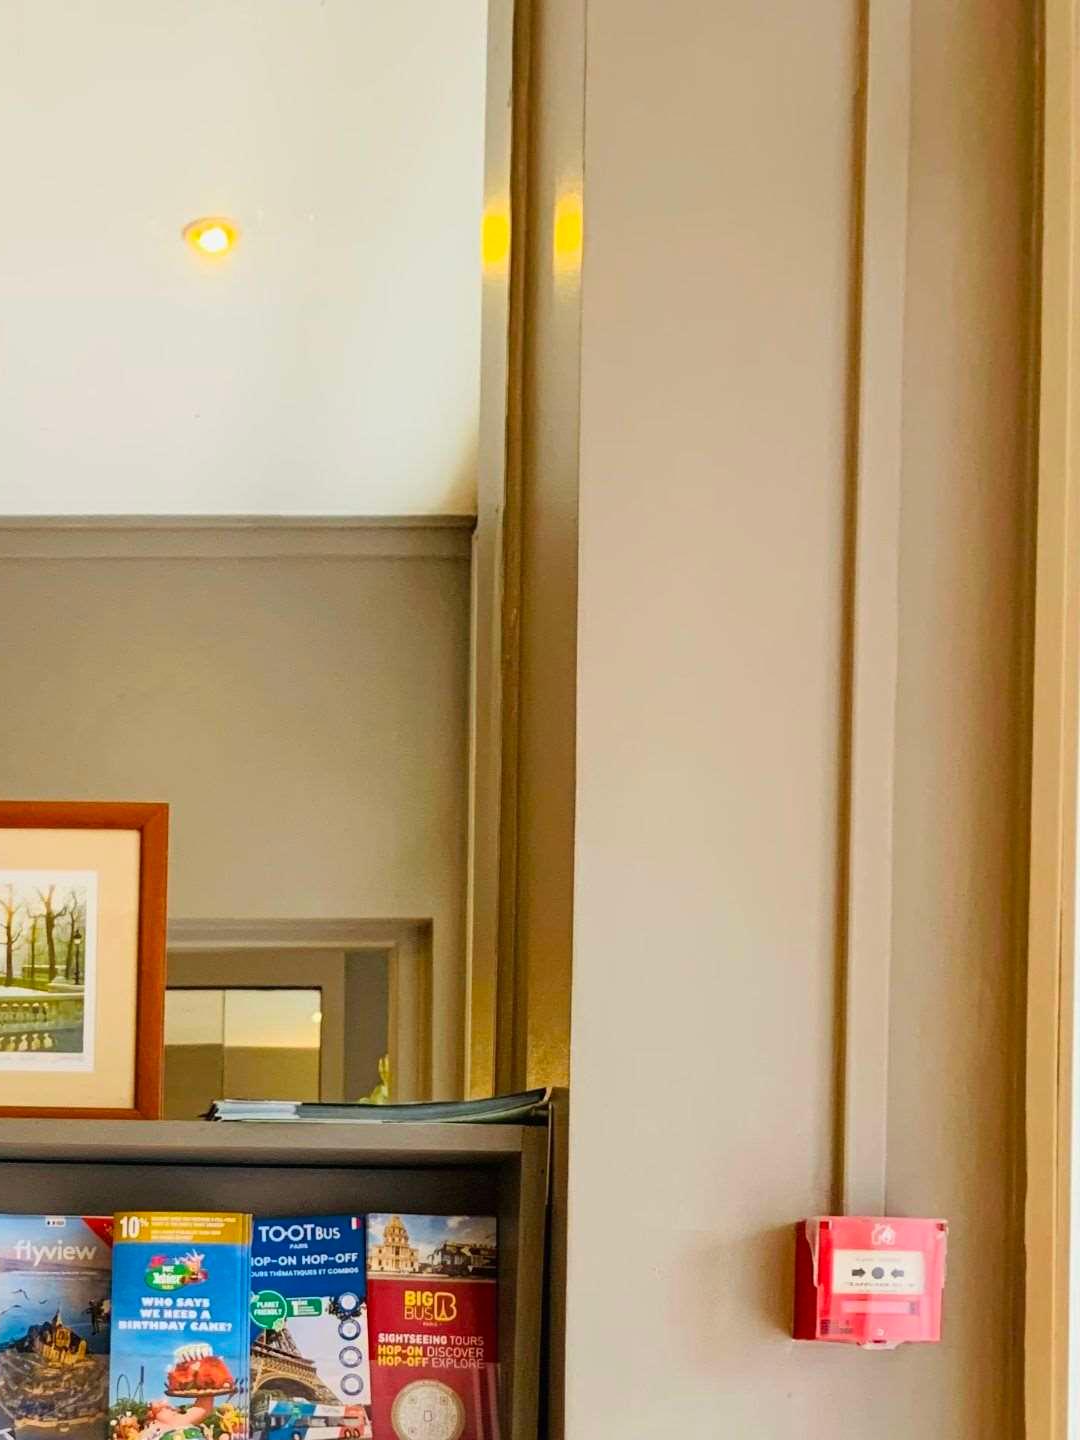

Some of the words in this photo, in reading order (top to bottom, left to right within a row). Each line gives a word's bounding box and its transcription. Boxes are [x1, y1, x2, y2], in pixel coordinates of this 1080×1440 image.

[13, 1239, 97, 1267] flyview
[301, 1252, 359, 1265] HOP-OFF
[140, 1297, 174, 1308] WHO
[176, 1297, 211, 1308] SAYS
[403, 1289, 433, 1307] BIG
[139, 1308, 161, 1319] WE
[163, 1309, 199, 1319] NEED
[200, 1310, 212, 1320] A
[404, 1305, 434, 1321] BUS
[118, 1320, 187, 1331] BIRTHDAY
[378, 1333, 448, 1345] SIGHTSEEING
[449, 1335, 485, 1347] TOURS
[378, 1344, 424, 1356] HOP-ON
[426, 1346, 485, 1359] DISCOVER
[378, 1355, 430, 1368] HOP-OFF
[431, 1356, 486, 1370] EXPLORE
